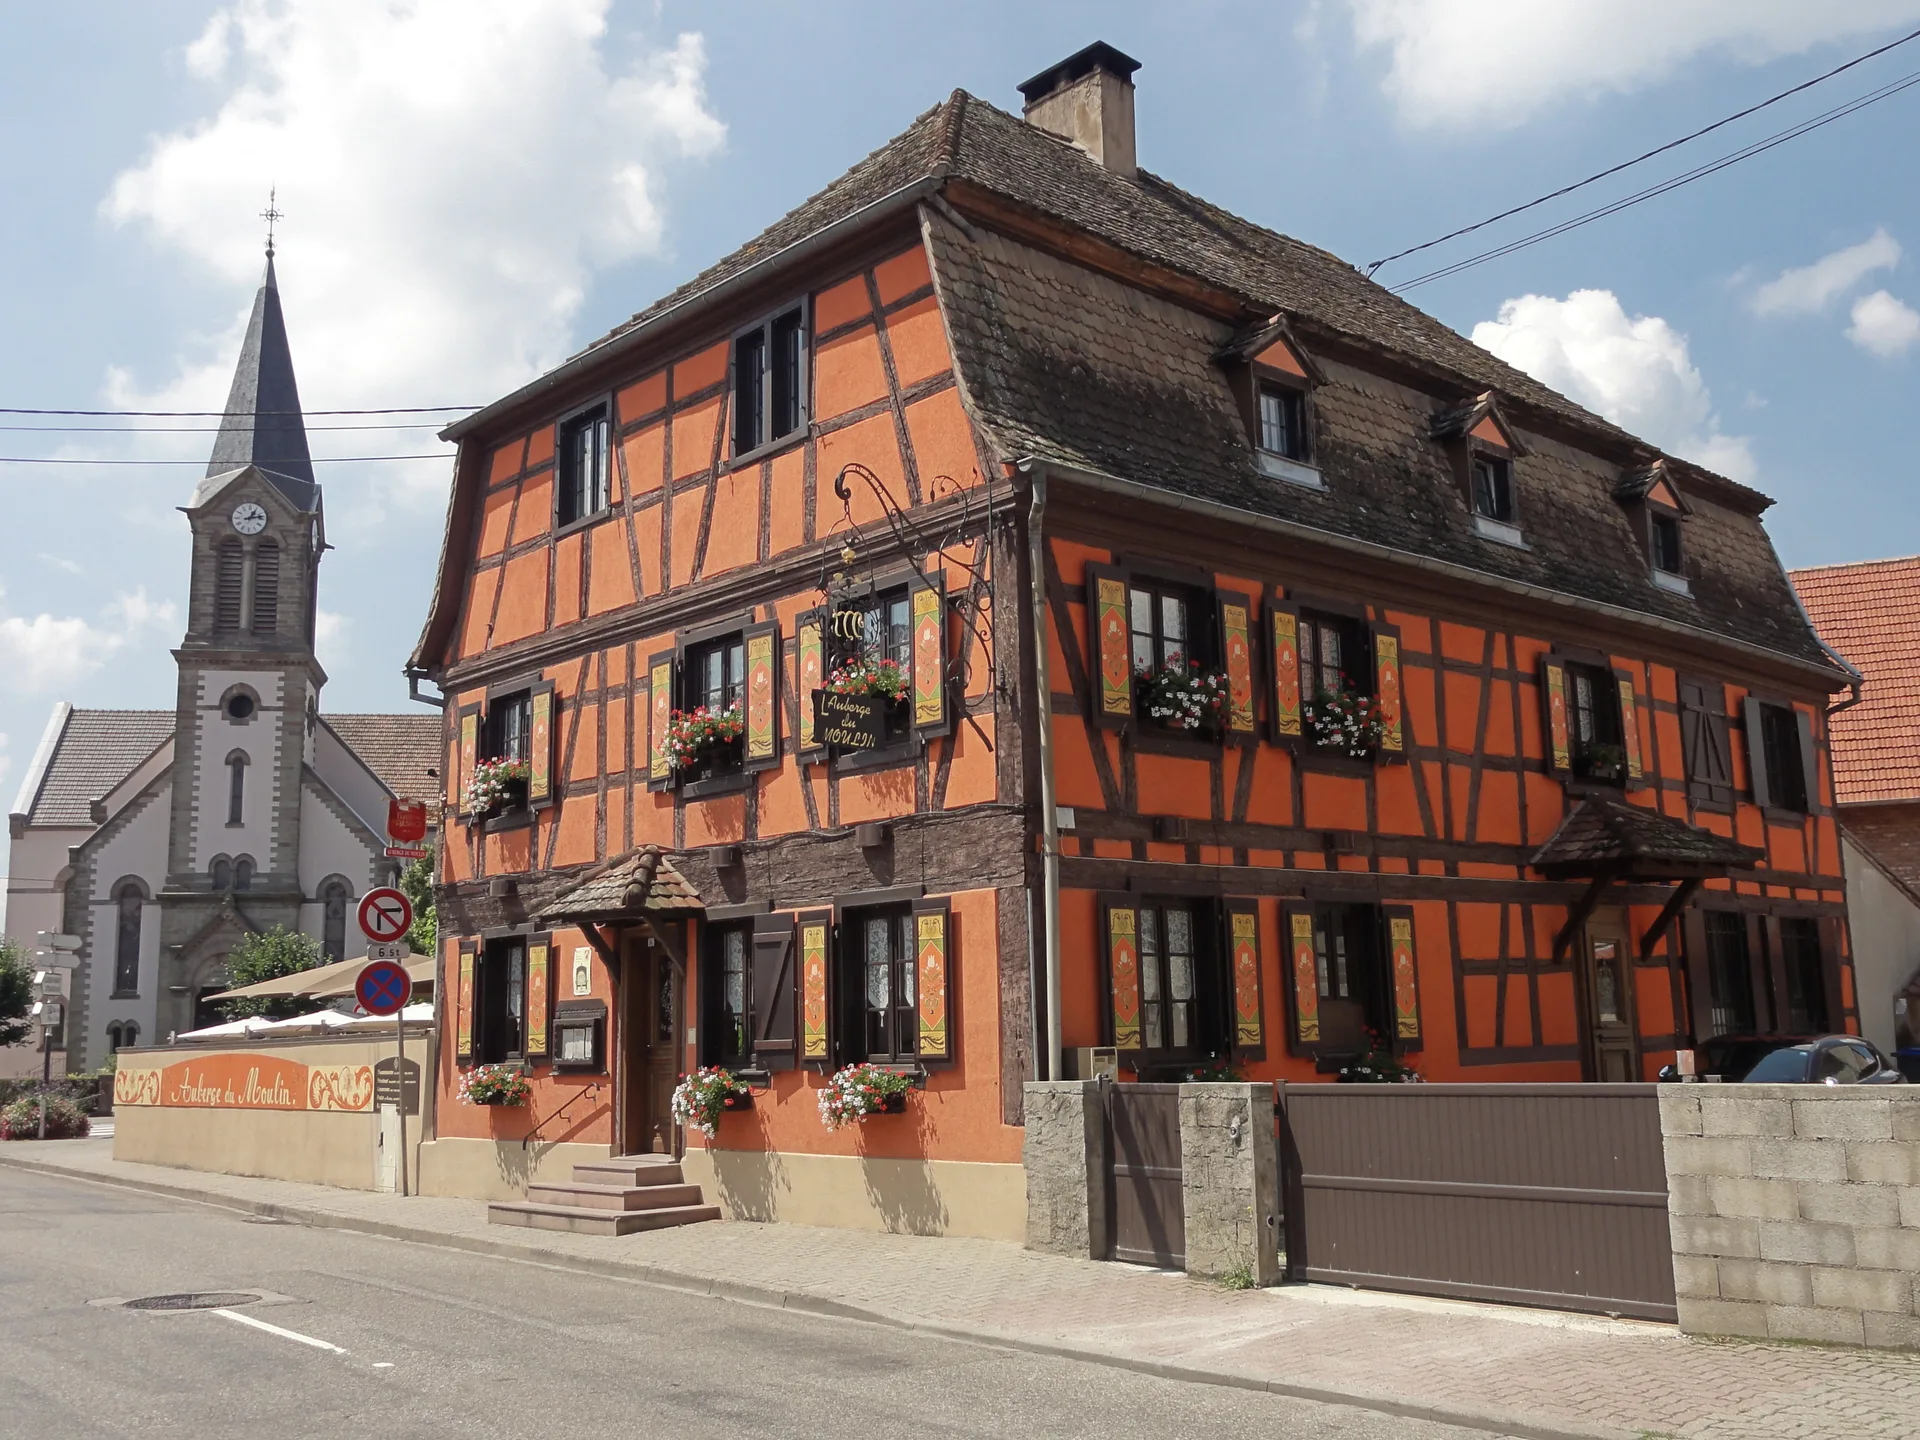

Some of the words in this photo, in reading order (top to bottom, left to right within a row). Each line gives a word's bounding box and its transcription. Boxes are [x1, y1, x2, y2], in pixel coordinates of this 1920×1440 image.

[841, 713, 856, 728] du
[823, 727, 876, 748] MOULIN
[171, 1067, 221, 1106] Auberge
[224, 1078, 235, 1104] du
